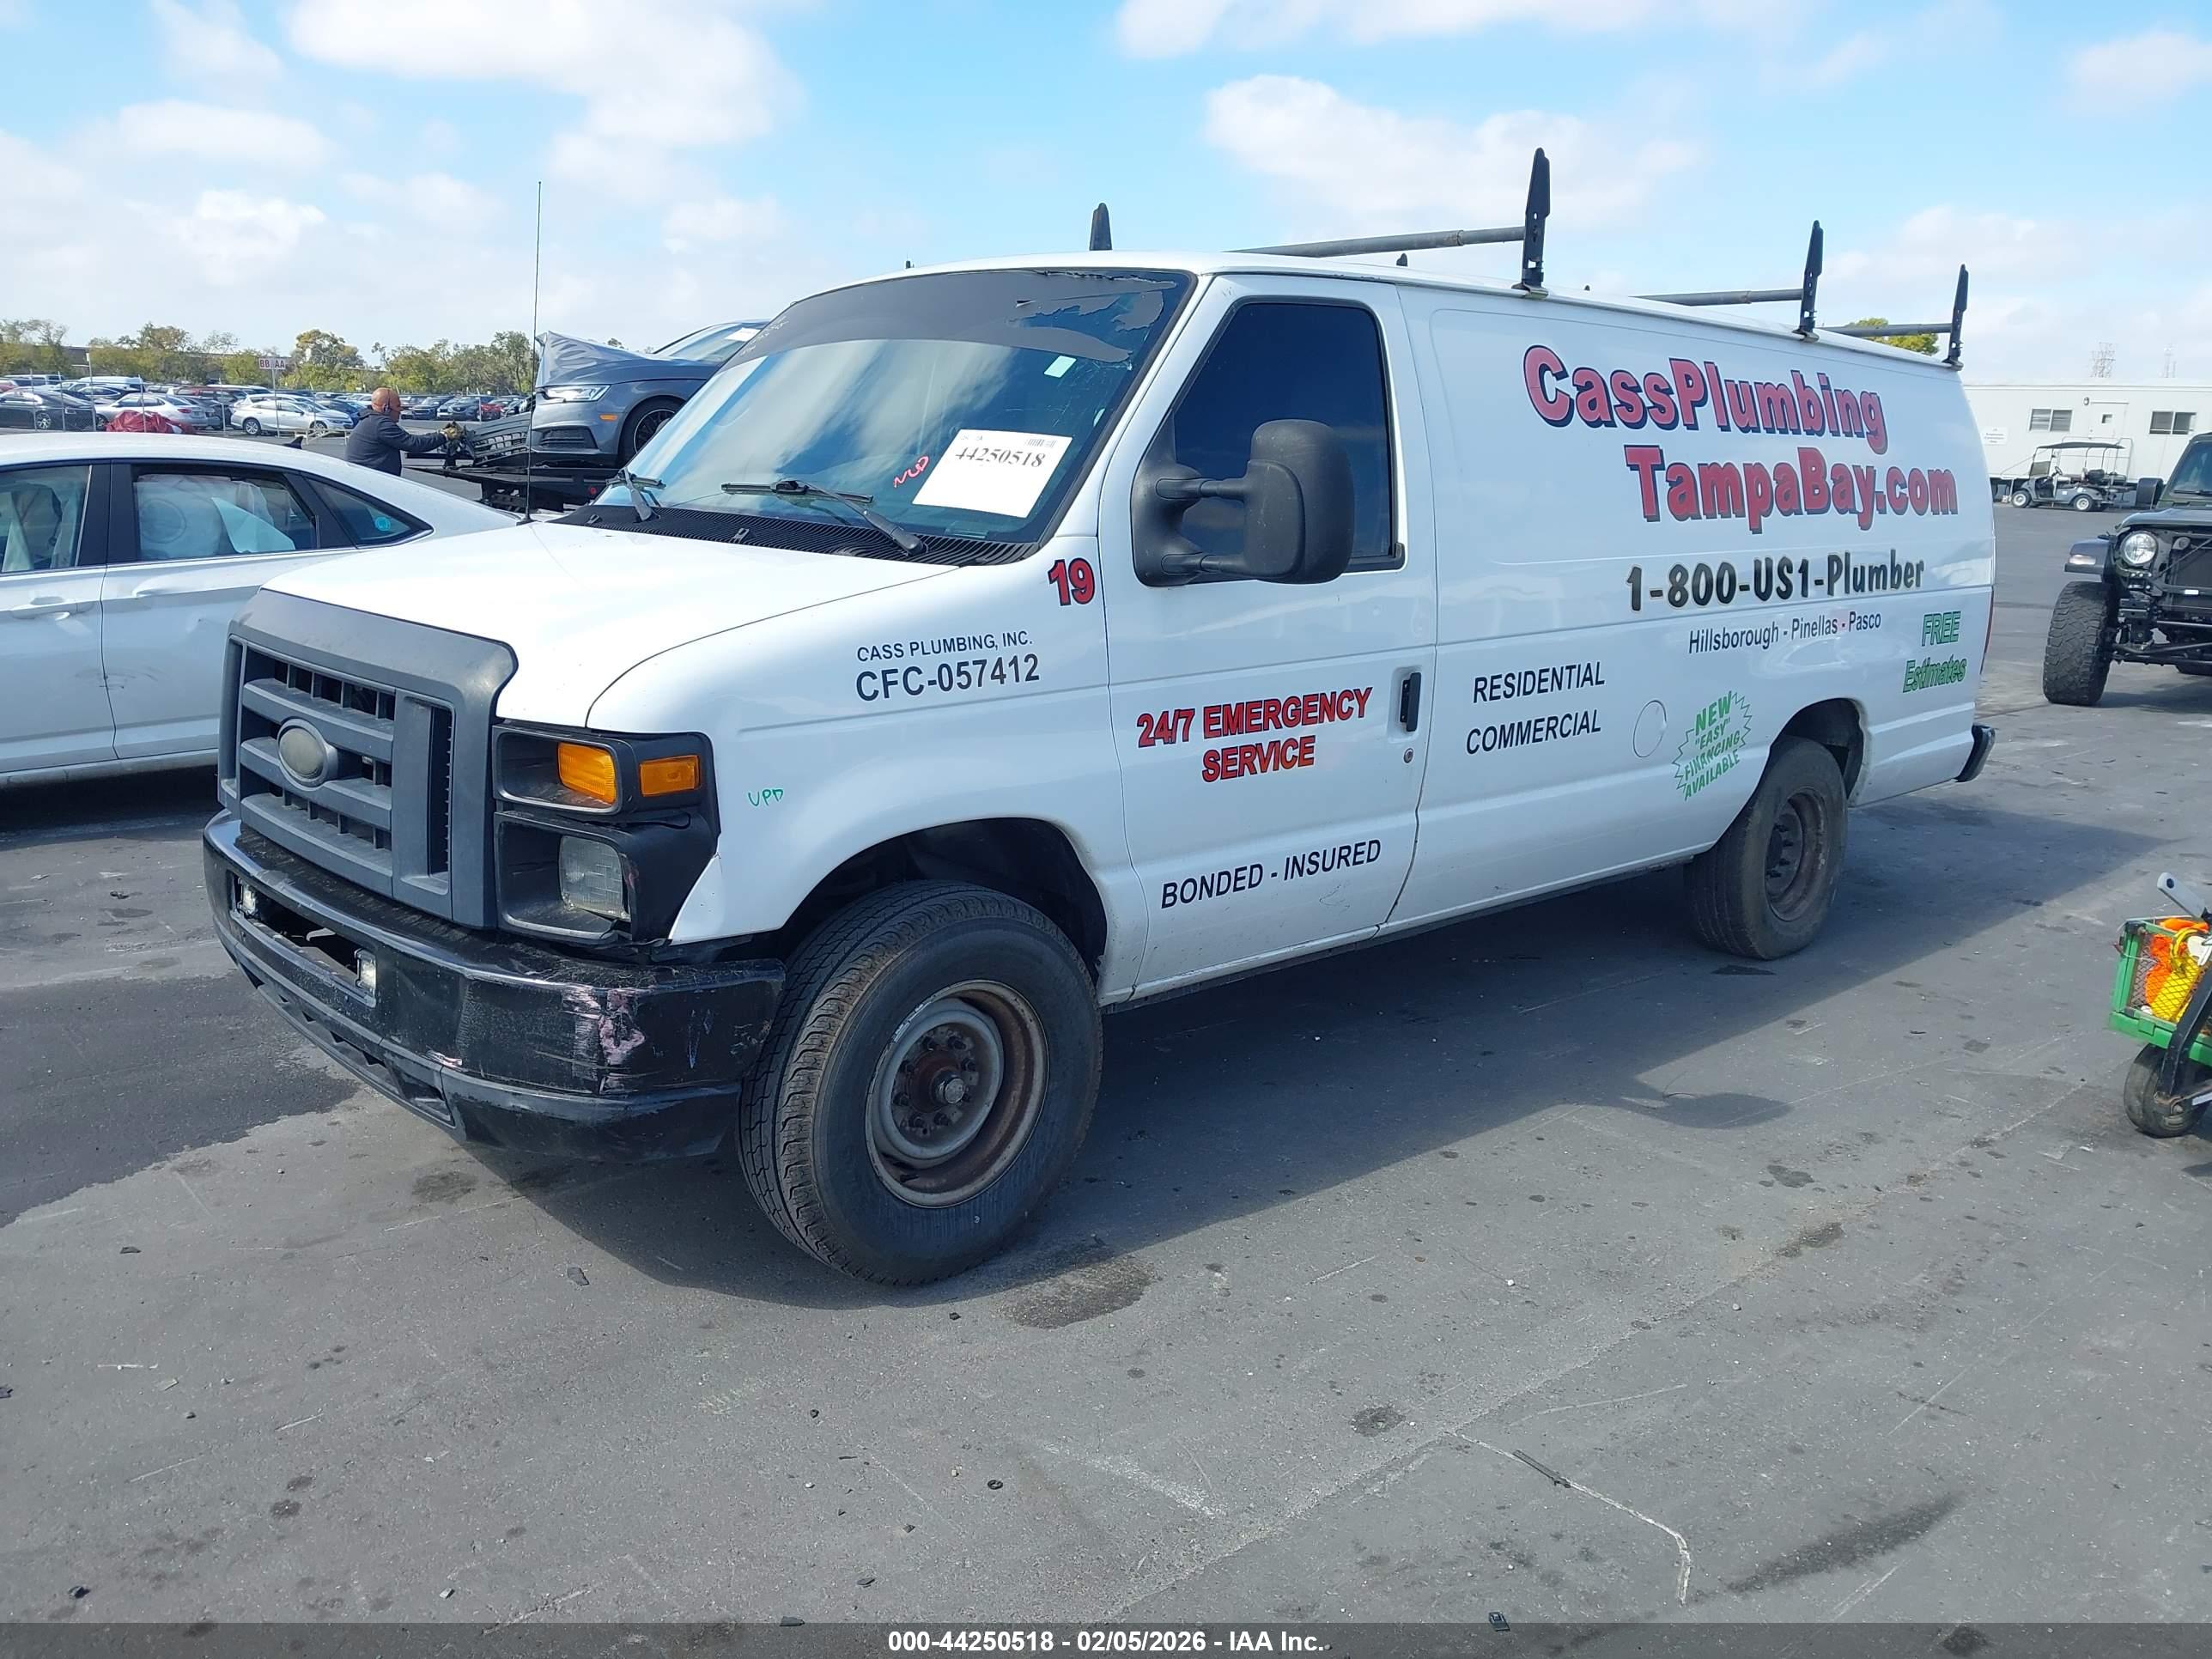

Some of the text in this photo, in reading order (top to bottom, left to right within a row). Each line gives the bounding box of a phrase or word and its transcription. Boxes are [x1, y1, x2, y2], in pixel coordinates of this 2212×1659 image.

[1523, 345, 1888, 454] CassPlumbing
[955, 447, 1046, 468] 44250518
[1624, 445, 1958, 534] TampaBay.com
[1048, 558, 1095, 605] 19
[1627, 550, 1924, 611] 1-800-US1-Plumber
[857, 631, 1033, 661] CASS PLUMBING, INC.
[1689, 621, 1778, 653] Hillsborough
[1792, 615, 1838, 640] Pinellas
[1849, 611, 1881, 631] Pasco
[1922, 611, 1961, 646] FREE
[856, 653, 1040, 702] CFC-057412
[1474, 661, 1605, 703] RESIDENTIAL
[1903, 654, 1967, 693] Estimates
[1138, 687, 1372, 748] 24/7 EMERGENCY
[1467, 709, 1601, 754] COMMERCIAL
[1695, 690, 1732, 736] NEW
[1202, 736, 1316, 782] SERVICE
[1683, 749, 1741, 801] AVAILABLE
[1684, 730, 1741, 781] FINANCING
[1161, 862, 1264, 908] BONDED
[1284, 839, 1381, 881] INSURED
